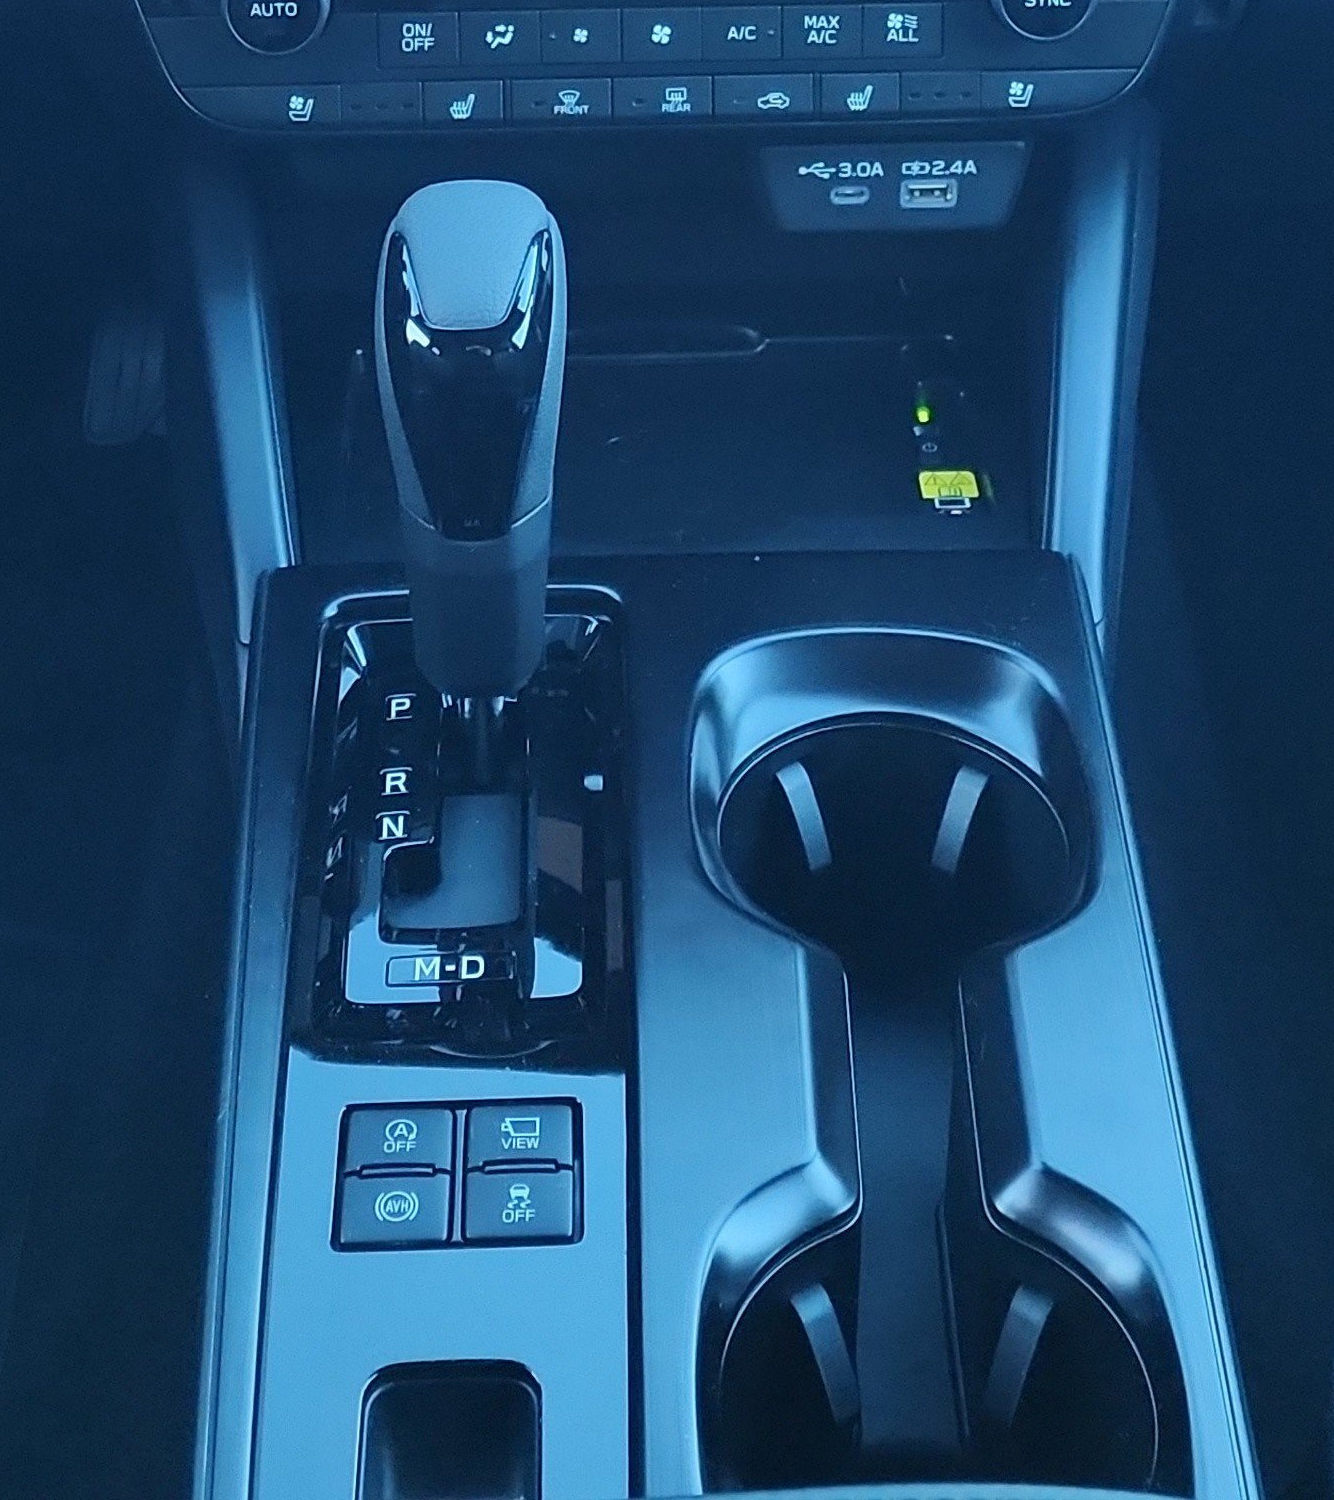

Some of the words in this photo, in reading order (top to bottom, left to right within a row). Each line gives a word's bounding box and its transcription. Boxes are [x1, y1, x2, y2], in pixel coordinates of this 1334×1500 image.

[250, 2, 298, 17] AUTO
[804, 15, 840, 29] MAX
[402, 23, 433, 37] ON/
[727, 26, 757, 41] A/C
[807, 30, 837, 44] A/C
[886, 28, 919, 43] ALL
[401, 38, 434, 52] OFF
[553, 103, 590, 115] FRONT
[662, 102, 692, 113] REAR
[838, 162, 884, 177] 3.0A
[932, 161, 977, 176] 2.4A
[390, 698, 411, 718] P
[385, 773, 409, 793] R
[382, 816, 404, 837] N
[384, 1141, 417, 1153] OFF
[502, 1138, 539, 1149] VIEW
[386, 1200, 409, 1212] AVH
[502, 1209, 535, 1223] OFF
